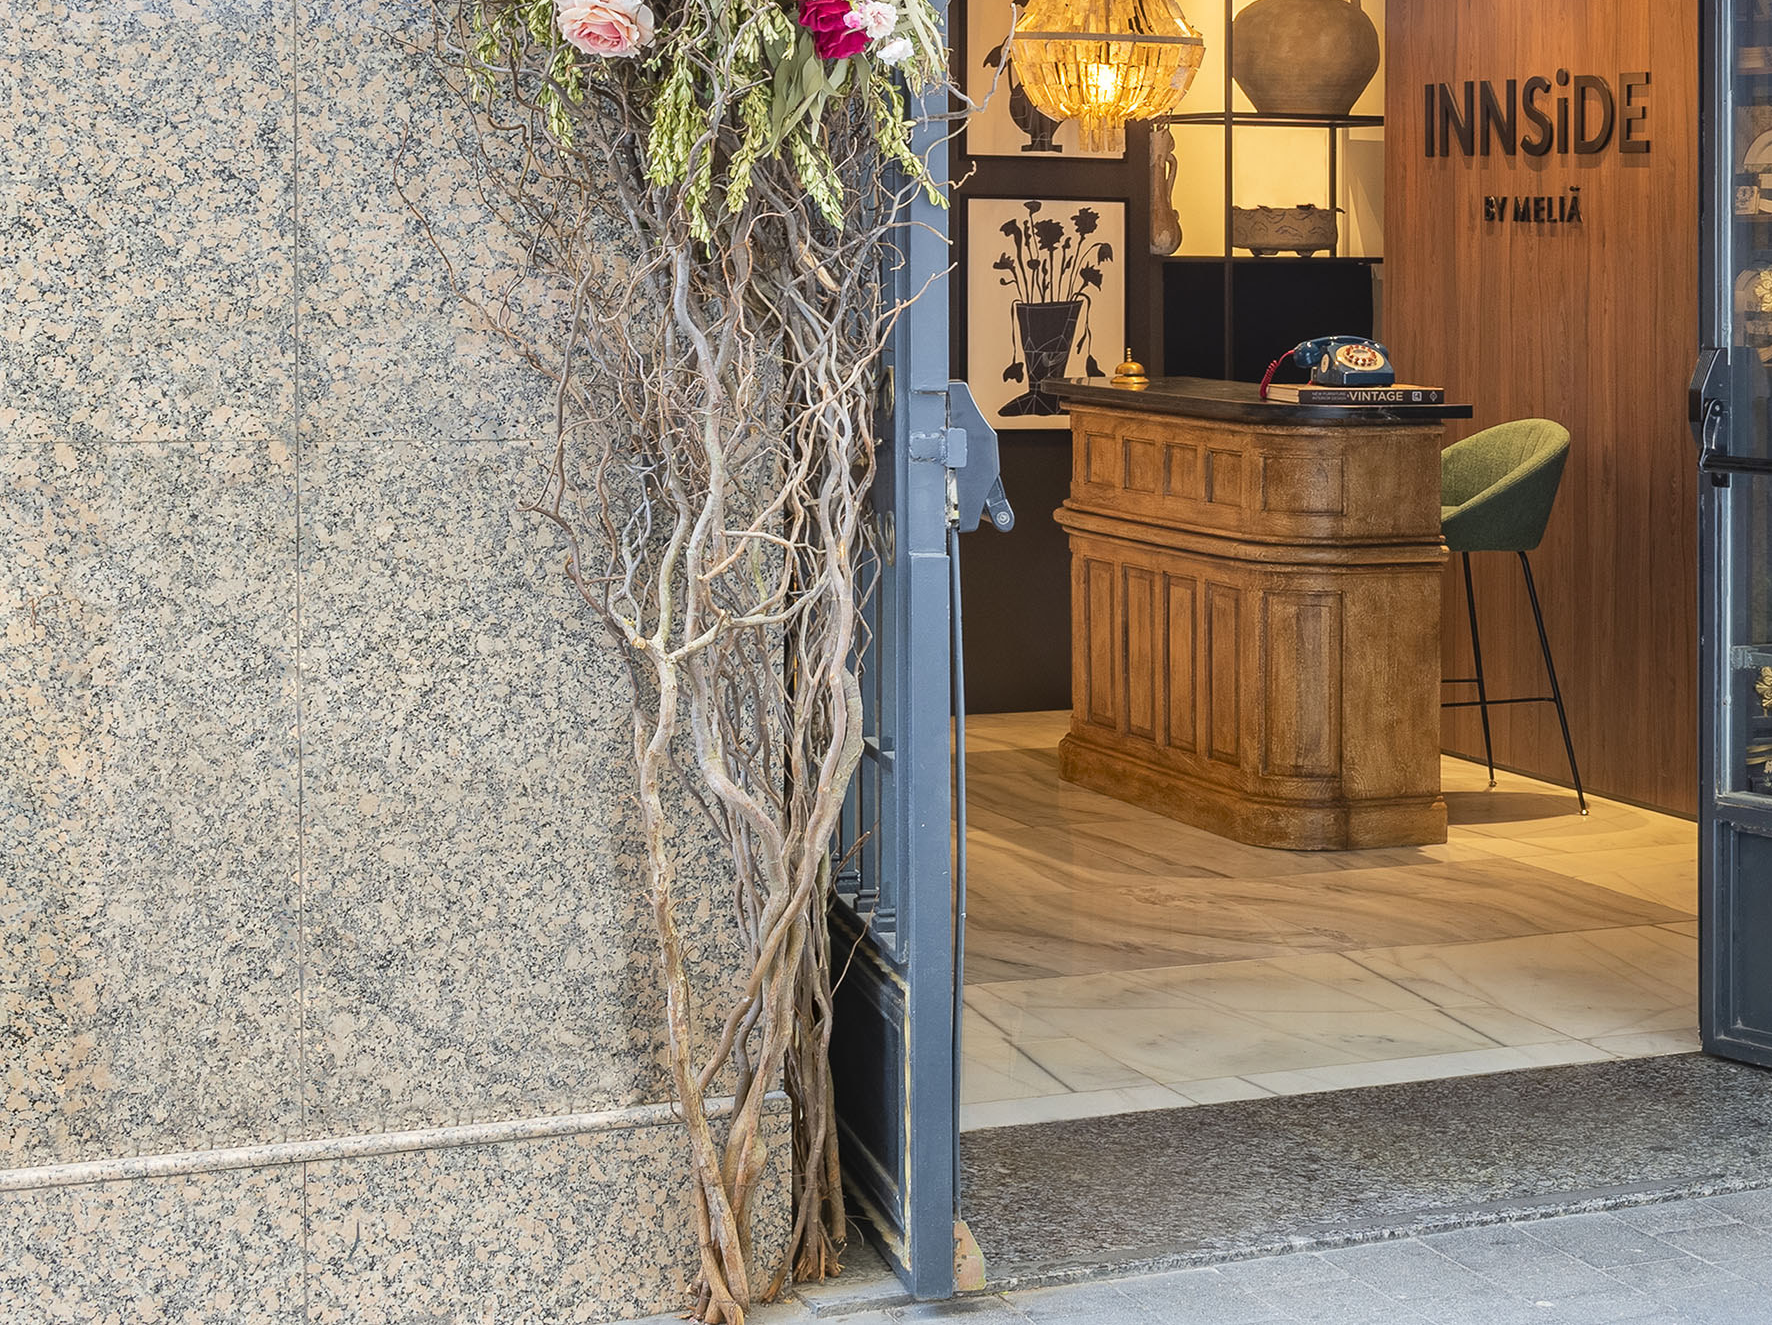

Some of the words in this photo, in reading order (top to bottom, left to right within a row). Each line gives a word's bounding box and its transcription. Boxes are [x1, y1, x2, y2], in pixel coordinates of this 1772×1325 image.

[1424, 68, 1651, 158] INNSiDE
[1484, 195, 1508, 223] BY
[1348, 391, 1404, 402] VINTAGE
